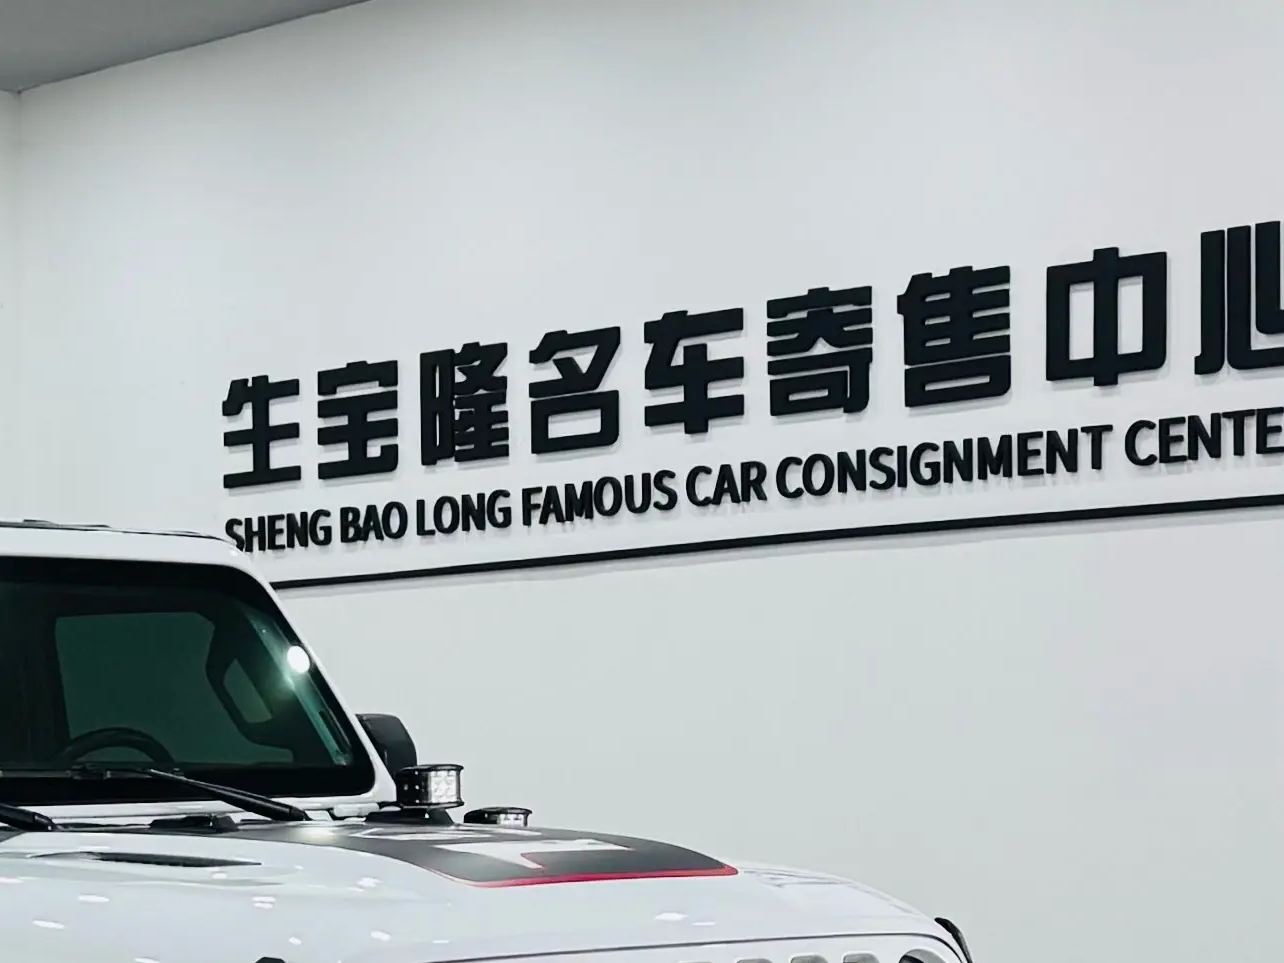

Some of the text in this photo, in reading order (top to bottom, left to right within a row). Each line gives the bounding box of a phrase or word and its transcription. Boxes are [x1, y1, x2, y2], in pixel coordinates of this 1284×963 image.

[222, 221, 1284, 489] 生宝隆名车寄售中心
[225, 509, 332, 552] SHENG
[340, 502, 408, 543] BAO
[417, 490, 512, 536] LONG
[522, 469, 677, 527] FAMOUS
[686, 461, 768, 507] CAR
[776, 424, 1114, 499] CONSIGNMENT
